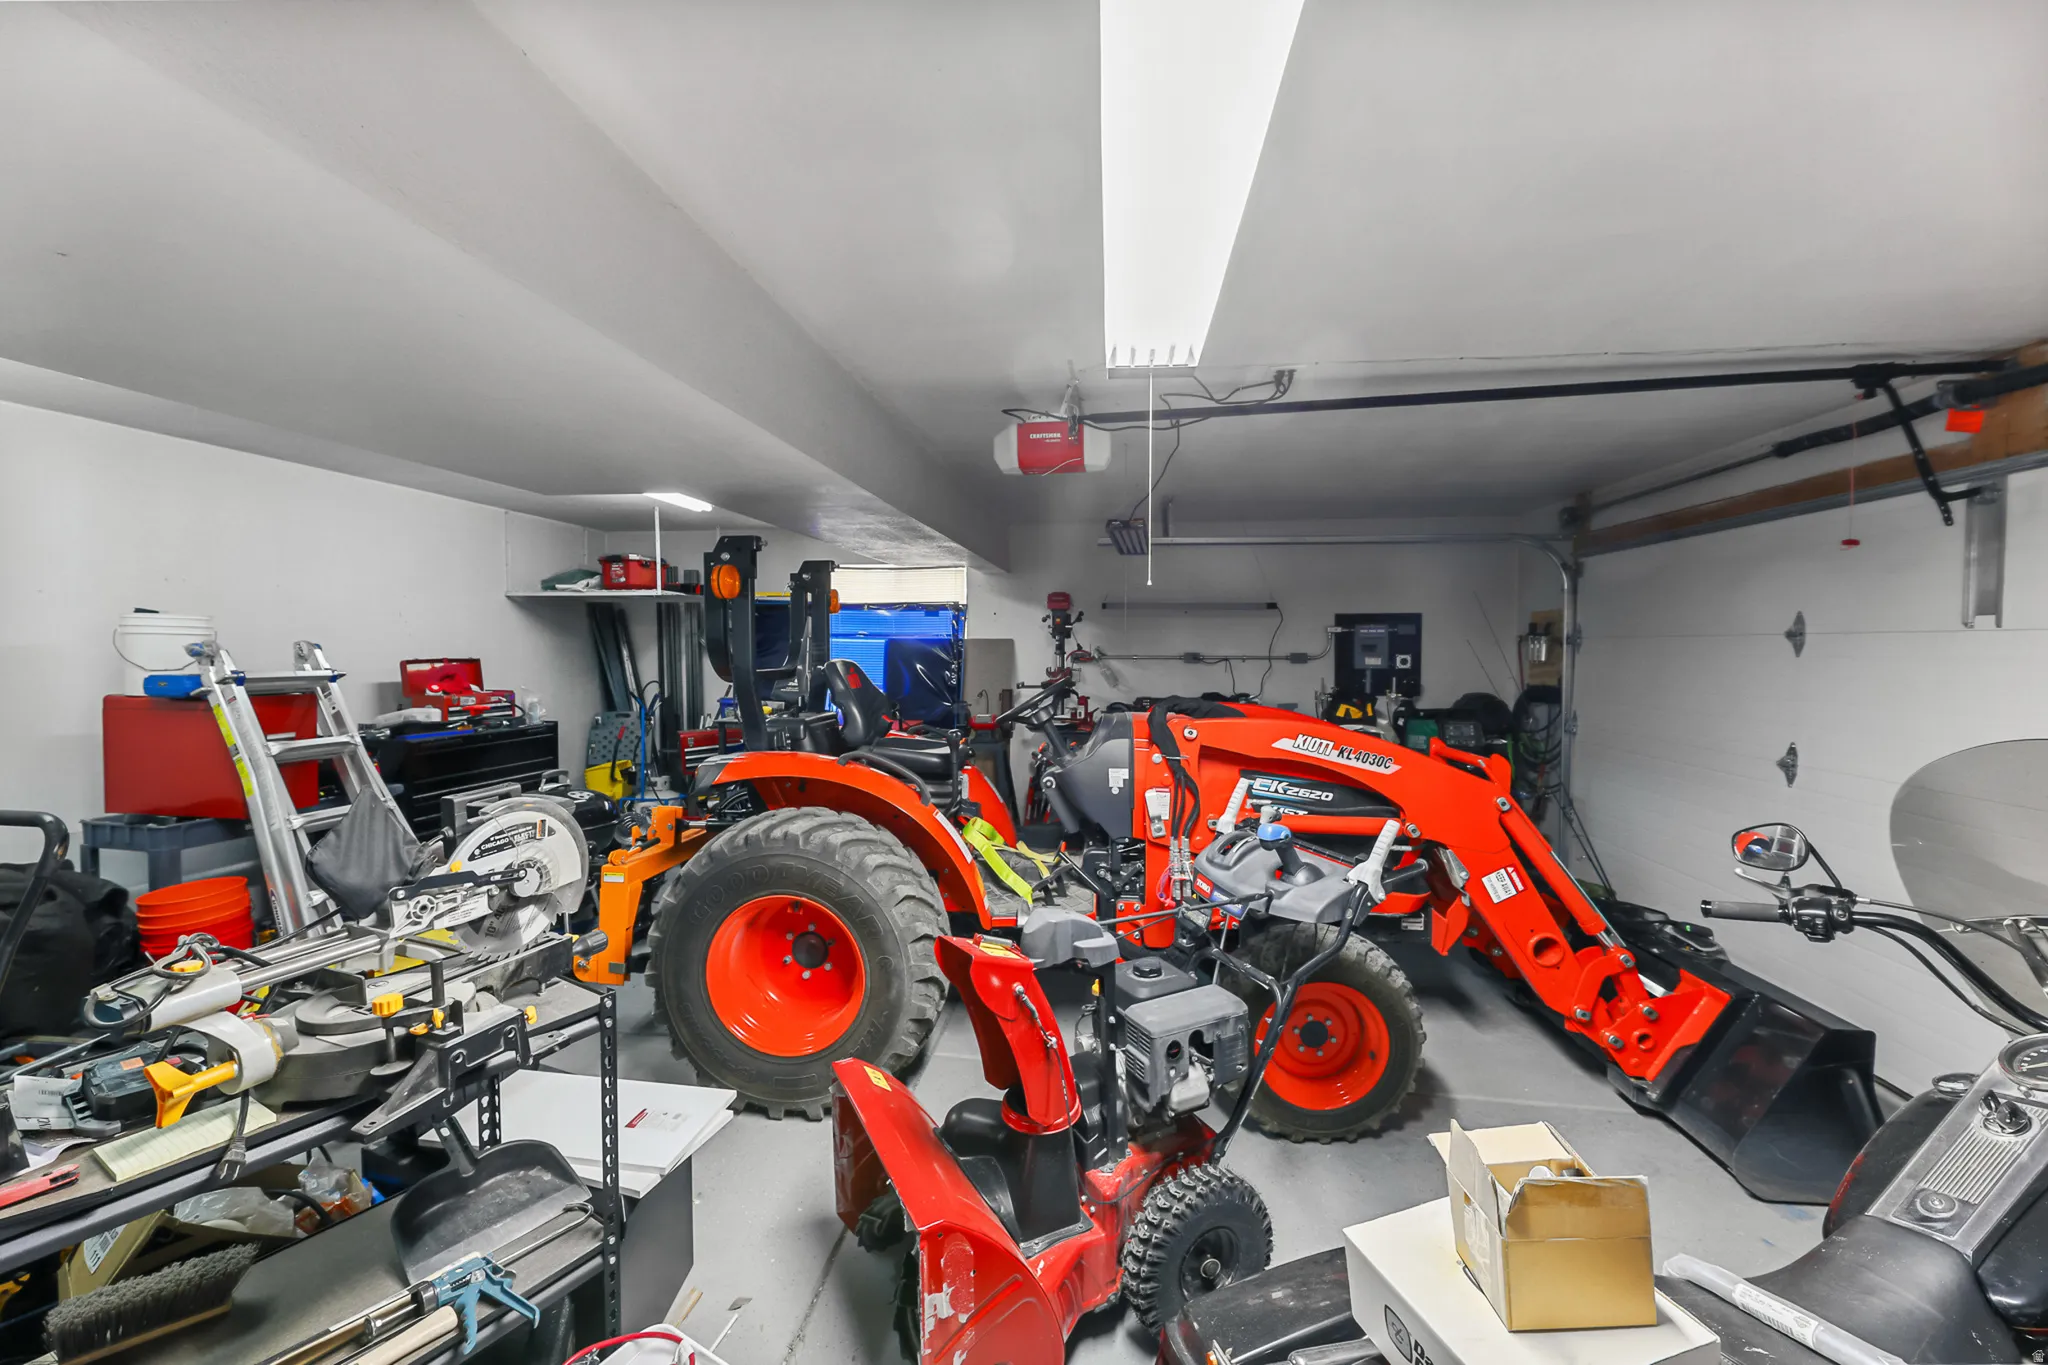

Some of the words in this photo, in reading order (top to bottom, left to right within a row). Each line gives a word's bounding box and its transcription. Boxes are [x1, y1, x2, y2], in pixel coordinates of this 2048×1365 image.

[1293, 733, 1335, 757] KIOTI
[1337, 745, 1393, 770] KL4030C
[481, 838, 510, 851] CHICAGO
